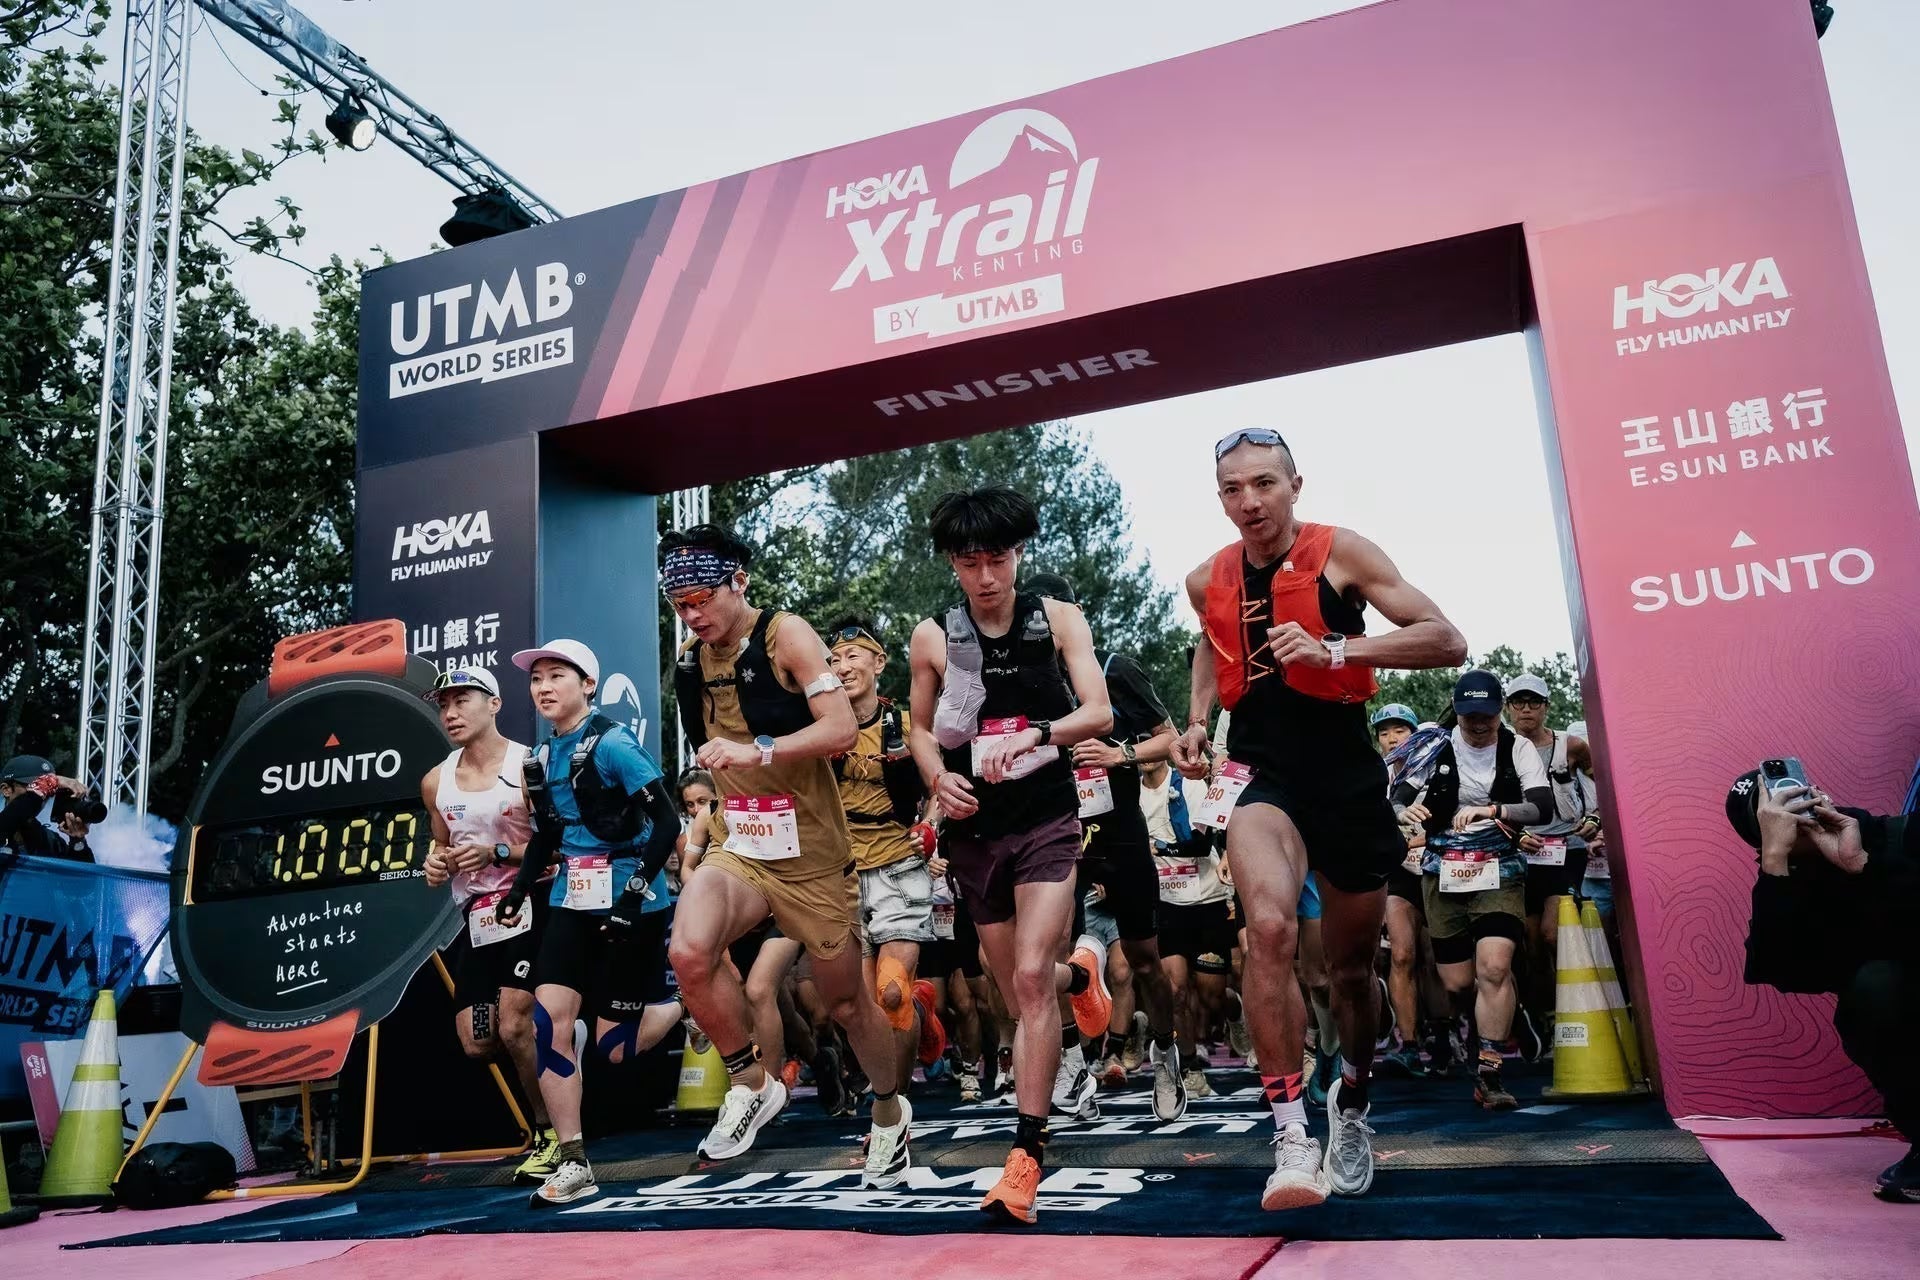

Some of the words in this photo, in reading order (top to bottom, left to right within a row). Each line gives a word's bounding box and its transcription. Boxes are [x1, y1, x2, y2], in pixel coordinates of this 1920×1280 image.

[826, 165, 929, 218] HOKA
[953, 239, 1084, 281] KENTING
[889, 306, 920, 332] BY
[957, 288, 1039, 323] UTMB
[1613, 256, 1790, 330] HOKA
[1616, 334, 1653, 356] FLY
[1657, 316, 1750, 348] HUMAN
[1753, 308, 1792, 331] FLY
[398, 353, 482, 388] WORLD
[492, 337, 566, 373] SERIES
[873, 349, 1160, 417] FINISHER
[1621, 387, 1827, 457] 玉山銀行
[1630, 453, 1727, 487] E.SUN
[1741, 436, 1834, 470] BANK
[391, 510, 492, 561] HOKA
[391, 565, 413, 582] FLY
[415, 554, 469, 577] HUMAN
[469, 550, 491, 568] FLY
[1630, 547, 1875, 612] SUUNTO
[413, 613, 500, 654] 山銀行
[446, 650, 498, 671] BANK
[260, 749, 401, 794] SUUNTO
[736, 823, 773, 836] 50001
[380, 870, 410, 880] SEIKO
[412, 869, 426, 877] Spo
[1450, 867, 1484, 877] 50057
[246, 1014, 327, 1030] SUUNTO
[611, 1000, 642, 1010] 2XU
[730, 1093, 763, 1143] TERREX
[604, 1194, 839, 1207] WORLD
